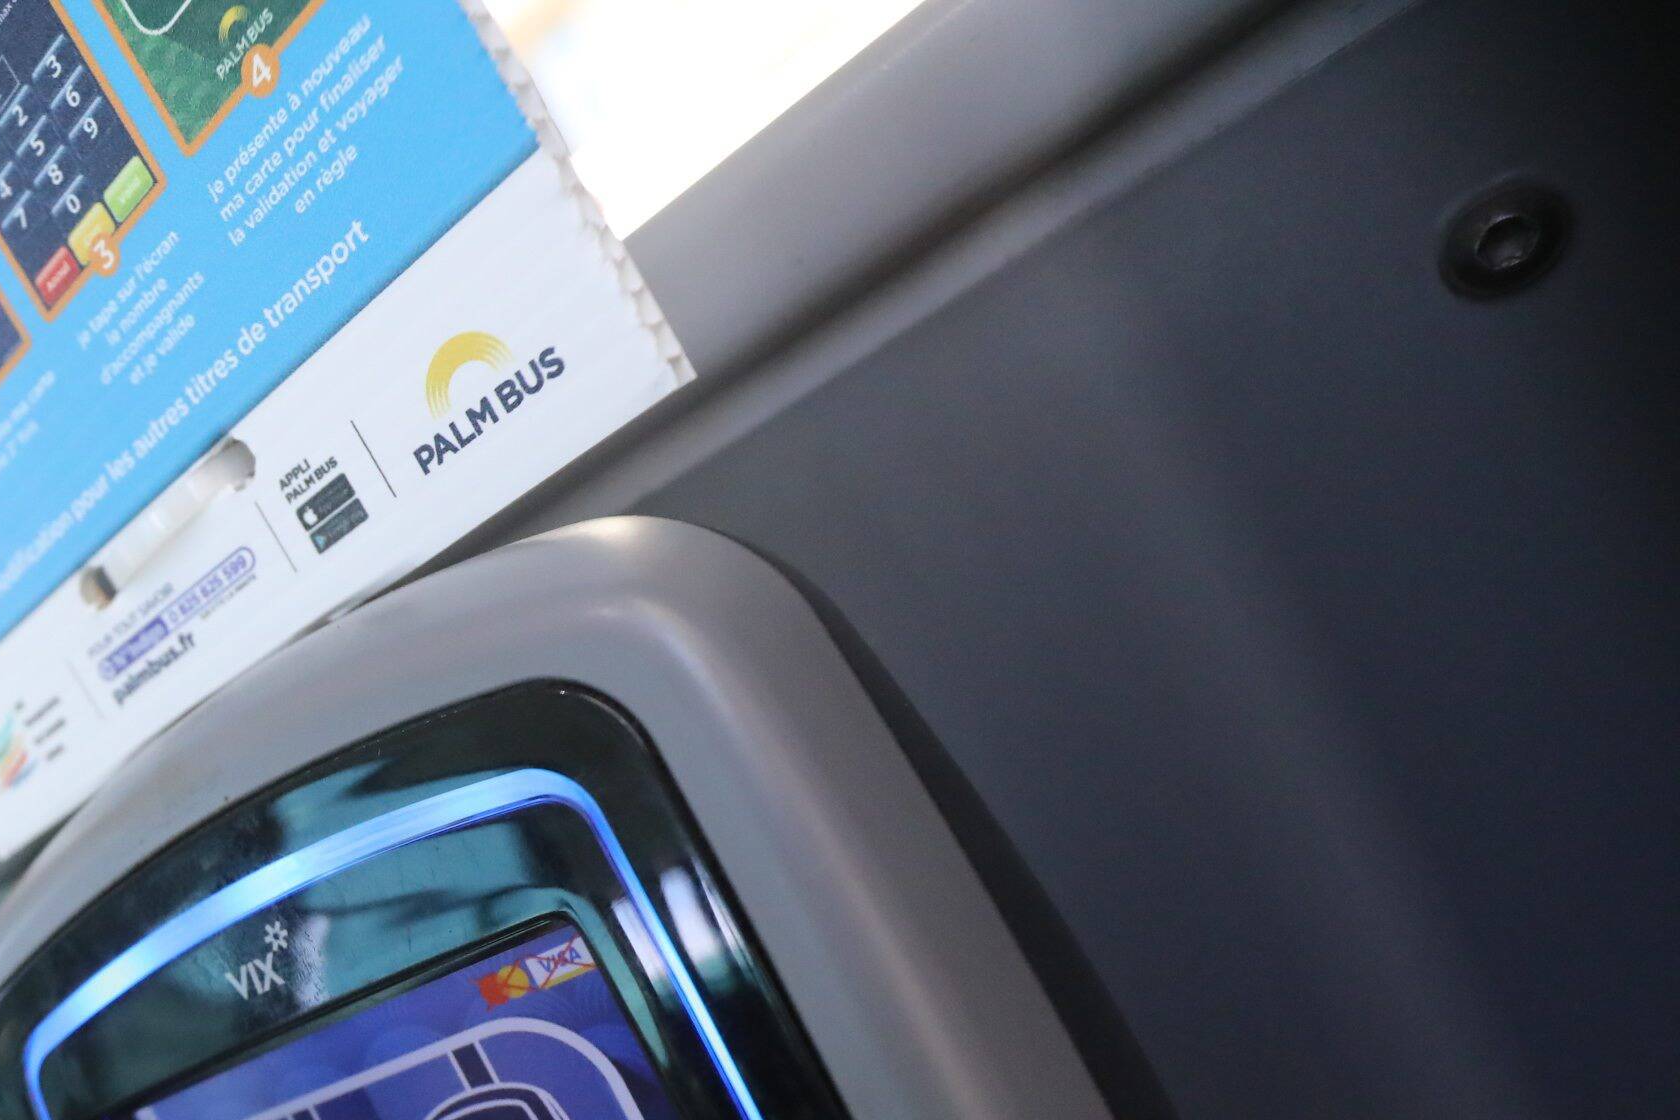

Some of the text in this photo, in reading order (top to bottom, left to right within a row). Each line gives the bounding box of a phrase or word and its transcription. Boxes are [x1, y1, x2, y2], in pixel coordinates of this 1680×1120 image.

[216, 7, 274, 81] PALM BUS
[251, 53, 271, 88] 4
[12, 104, 29, 127] 2
[46, 54, 62, 79] 3
[30, 134, 46, 157] 5
[66, 84, 81, 108] 6
[207, 13, 371, 204] je présente à nouveau
[220, 34, 386, 222] ma carte pour finaliser
[228, 55, 404, 247] la validation et voyager
[12, 117, 98, 230] 7 8 9
[66, 194, 82, 215] 0
[294, 145, 358, 215] en règle
[92, 238, 116, 271] 3
[117, 275, 137, 300] sur
[120, 278, 168, 335] nombre
[70, 475, 109, 522] pour
[104, 448, 136, 480] les
[133, 398, 189, 458] autres
[185, 349, 240, 406] titres
[237, 320, 266, 355] de
[262, 218, 369, 328] transport
[130, 365, 146, 386] et
[413, 346, 565, 476] PALM BUS
[279, 458, 311, 491] APPLI
[285, 475, 316, 505] PALM
[314, 456, 338, 481] BUS
[225, 952, 285, 1001] VIX
